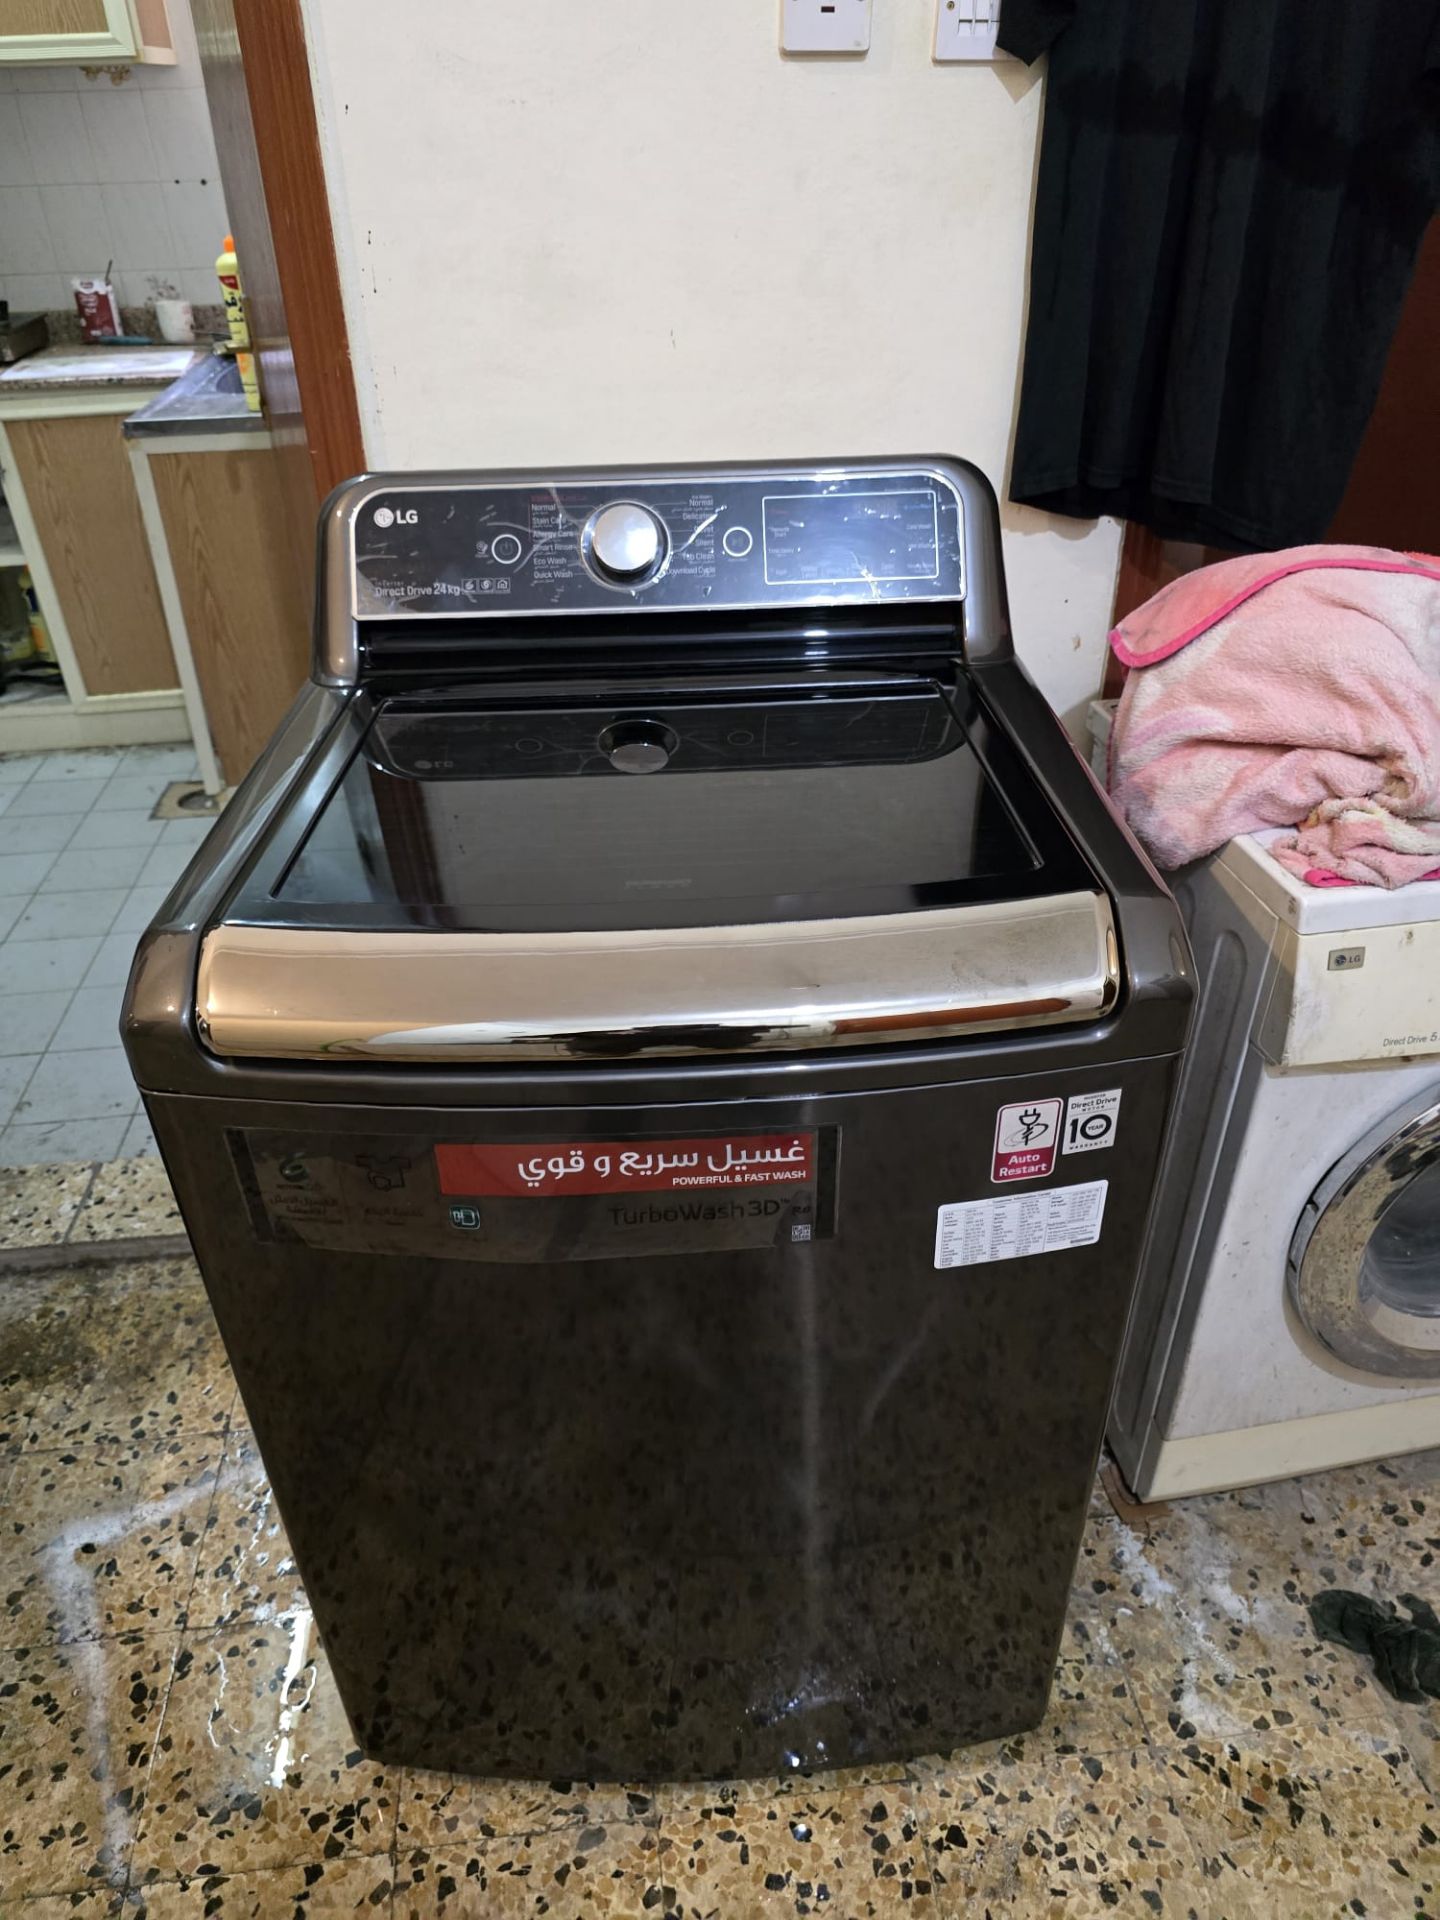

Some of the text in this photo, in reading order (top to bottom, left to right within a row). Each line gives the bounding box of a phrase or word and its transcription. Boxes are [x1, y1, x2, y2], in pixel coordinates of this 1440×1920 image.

[532, 503, 556, 511] Normal
[689, 499, 713, 507] Normal
[395, 509, 419, 525] LG
[557, 530, 574, 538] Care
[547, 557, 567, 565] Wash
[695, 552, 715, 560] Clean
[534, 570, 573, 579] Quick Wash
[698, 566, 716, 576] Cycle
[375, 586, 405, 597] Direct
[407, 585, 433, 596] Drive
[1349, 955, 1361, 963] LG
[1382, 1036, 1406, 1047] Direct
[1407, 1035, 1428, 1045] Drive
[1071, 1100, 1095, 1110] Direct
[1096, 1096, 1117, 1106] Drive
[1069, 1114, 1112, 1143] 10
[1087, 1123, 1105, 1131] YEAR
[517, 1139, 805, 1188] غسيل سريع و قوي
[1008, 1154, 1040, 1165] Auto
[998, 1162, 1048, 1177] Restart
[672, 1169, 806, 1186] POWERFUL & FAST WASH
[608, 1201, 745, 1226] TurboWash
